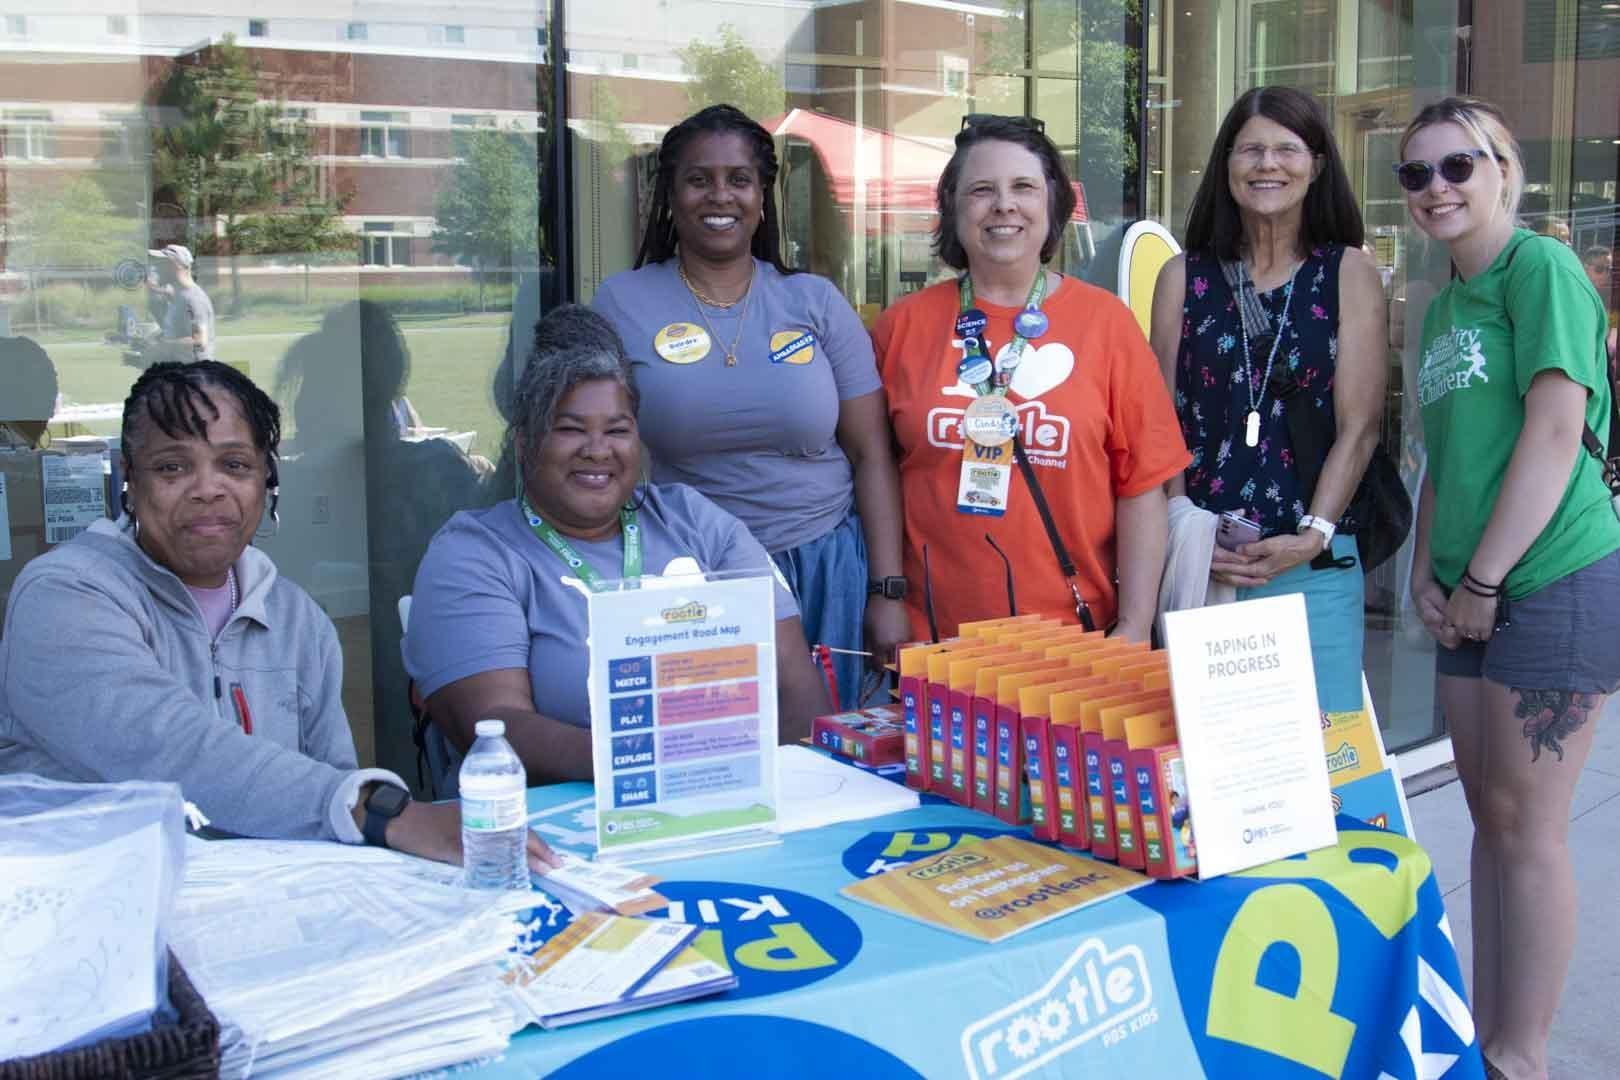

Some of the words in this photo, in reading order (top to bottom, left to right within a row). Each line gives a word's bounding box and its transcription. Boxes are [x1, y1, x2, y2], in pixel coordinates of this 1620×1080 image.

[957, 318, 986, 330] SCIENCE
[974, 446, 1003, 460] VIP
[1027, 455, 1067, 469] Channel
[664, 606, 705, 620] rootle
[624, 631, 690, 647] Engagement
[692, 626, 718, 638] Road
[719, 624, 742, 635] Map
[1204, 635, 1258, 657] TAPING
[1260, 631, 1277, 649] IN
[1207, 652, 1281, 680] PROGRESS
[614, 676, 648, 688] WATCH
[620, 714, 644, 726] PLAY
[614, 751, 653, 766] EXPLORE
[621, 790, 649, 803] SHARE
[1056, 746, 1074, 829] STEM
[1087, 754, 1105, 839] STEM
[1137, 771, 1161, 860] STEM
[916, 855, 978, 878] rootle
[936, 869, 1005, 894] Follow
[1005, 861, 1030, 873] us
[948, 894, 978, 909] on
[976, 863, 1069, 898] Instagram
[974, 870, 1110, 920] @rootlenc
[979, 959, 1135, 1075] rootle
[1102, 1024, 1129, 1048] PBS
[1130, 1007, 1160, 1032] KIDS
